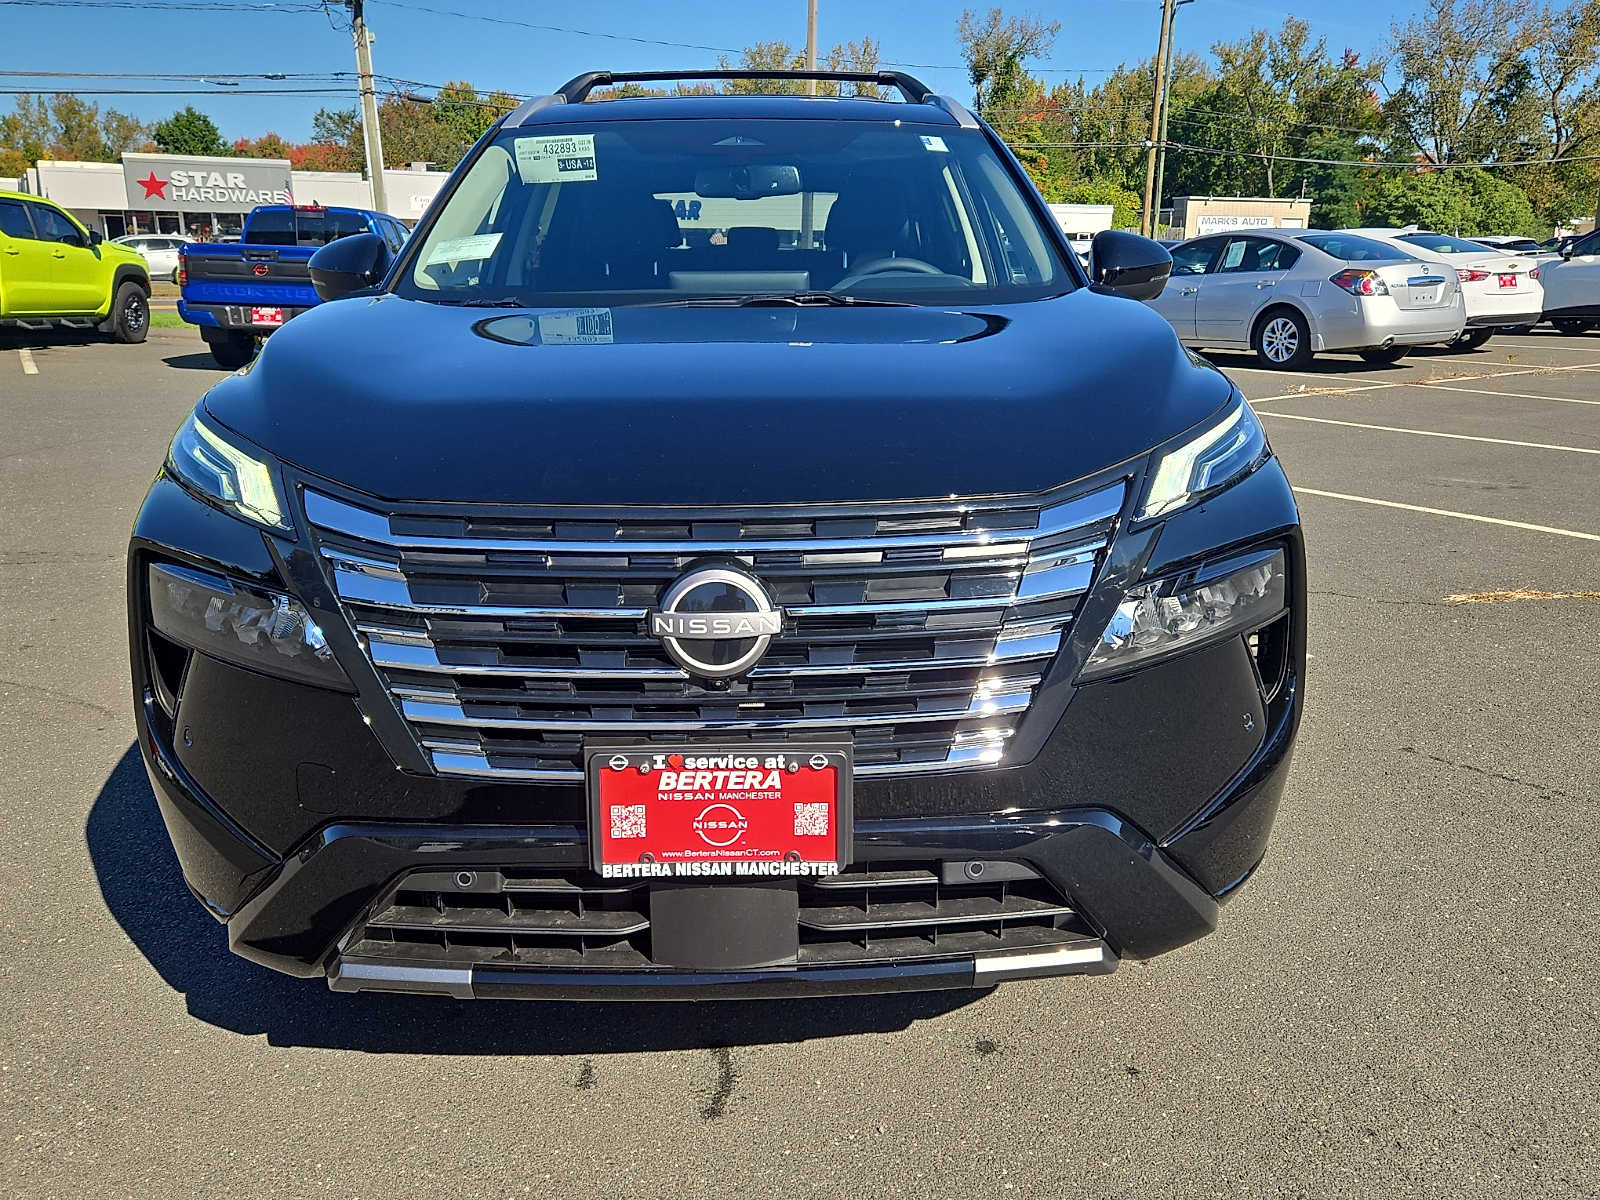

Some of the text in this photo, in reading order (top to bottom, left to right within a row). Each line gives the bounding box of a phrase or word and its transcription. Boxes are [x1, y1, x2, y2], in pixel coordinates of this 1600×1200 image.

[543, 142, 577, 155] 432893
[565, 160, 583, 169] USA
[170, 170, 248, 189] STAR
[172, 187, 285, 204] HARDWARE
[1201, 217, 1268, 226] MARK'S AUTO
[655, 616, 779, 633] NISSAN
[652, 754, 785, 769] I service at
[658, 771, 782, 790] BERTERA
[658, 792, 782, 801] NISSAN MANCHESTER
[693, 820, 748, 829] NISSAN
[661, 849, 780, 858] www.BerteraNissanCT.com
[602, 862, 839, 878] BERTERA NISSAN MANCHESTER
